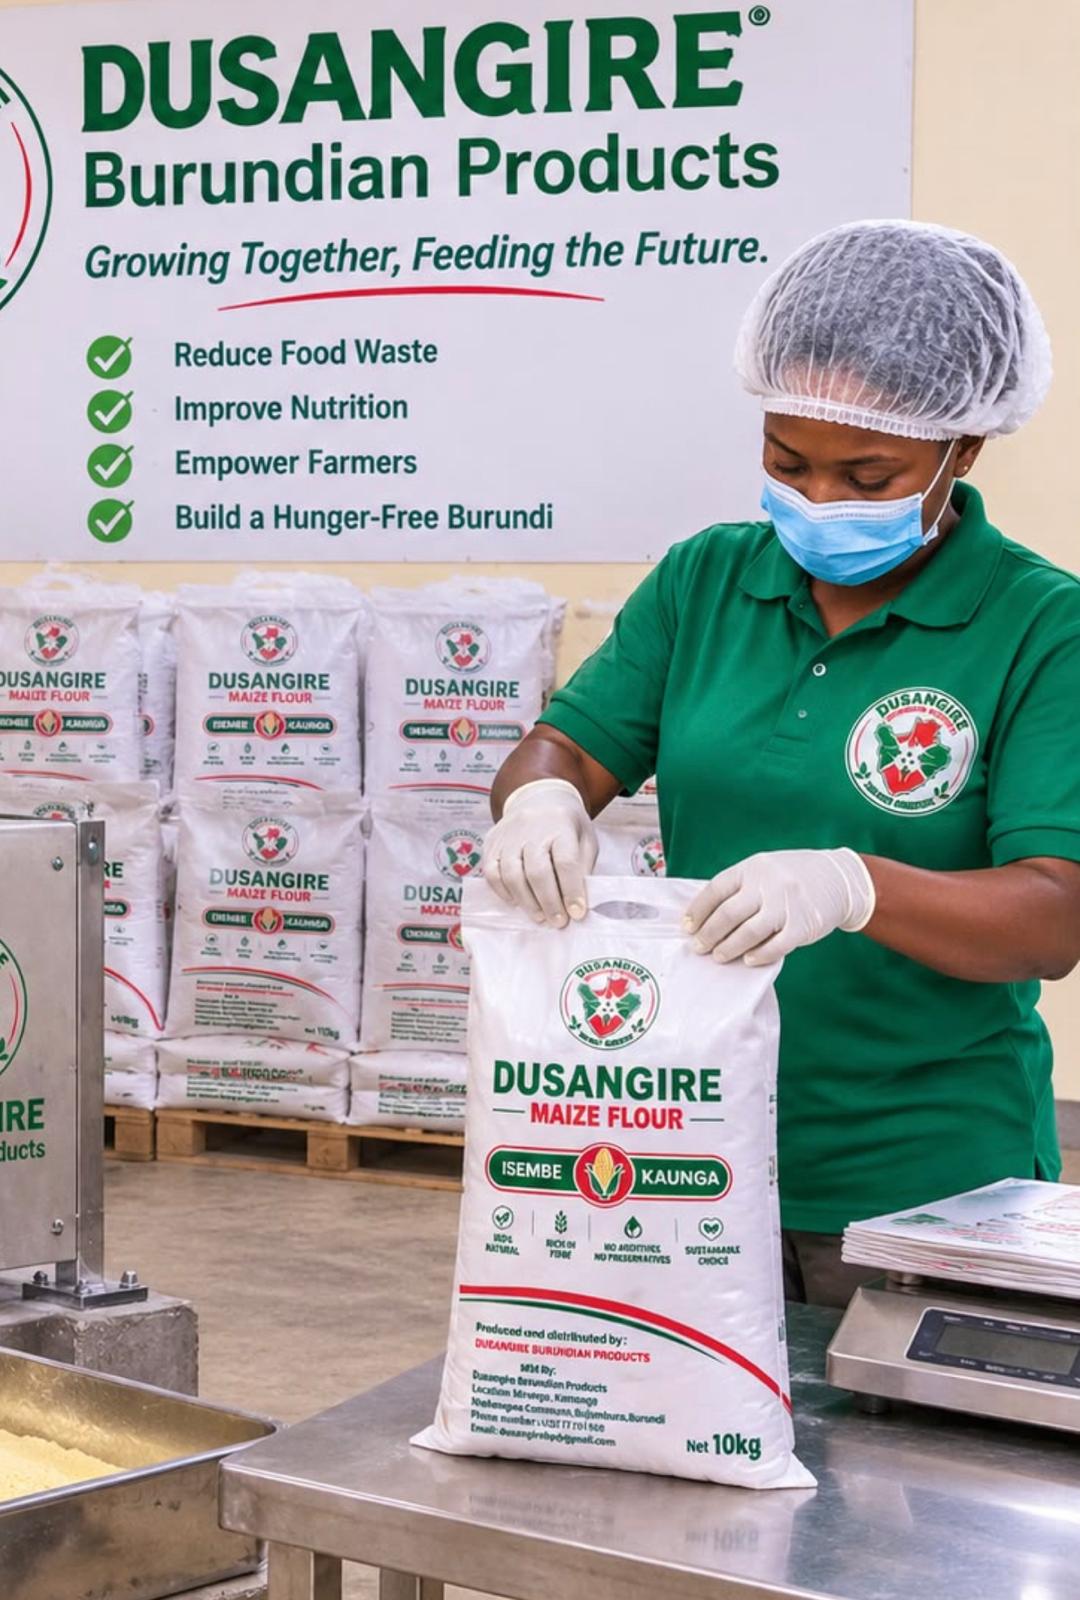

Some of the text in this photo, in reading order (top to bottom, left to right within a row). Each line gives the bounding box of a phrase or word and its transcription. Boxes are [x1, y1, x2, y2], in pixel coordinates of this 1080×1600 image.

[81, 11, 743, 132] DUSANGIRE
[84, 133, 780, 207] Burundian Products
[85, 232, 769, 284] Growing Together, Feeding the Future.
[175, 339, 438, 367] Reduce Food Waste
[175, 395, 408, 427] Improve Nutrition
[175, 450, 417, 481] Empower Farmers
[175, 503, 553, 536] Build a Hunger-Free Burundi
[208, 672, 330, 690] DUSANGIRE
[405, 678, 520, 698] DUSANGIRE
[209, 868, 329, 890] DUSANGIRE
[270, 890, 311, 902] FLOUR
[493, 1060, 723, 1102] DUSANGIRE
[530, 1102, 684, 1129] MAIZE FLOUR
[501, 1161, 721, 1186] ISEMBE KAUNGA
[686, 1433, 762, 1461] Net 10kg
